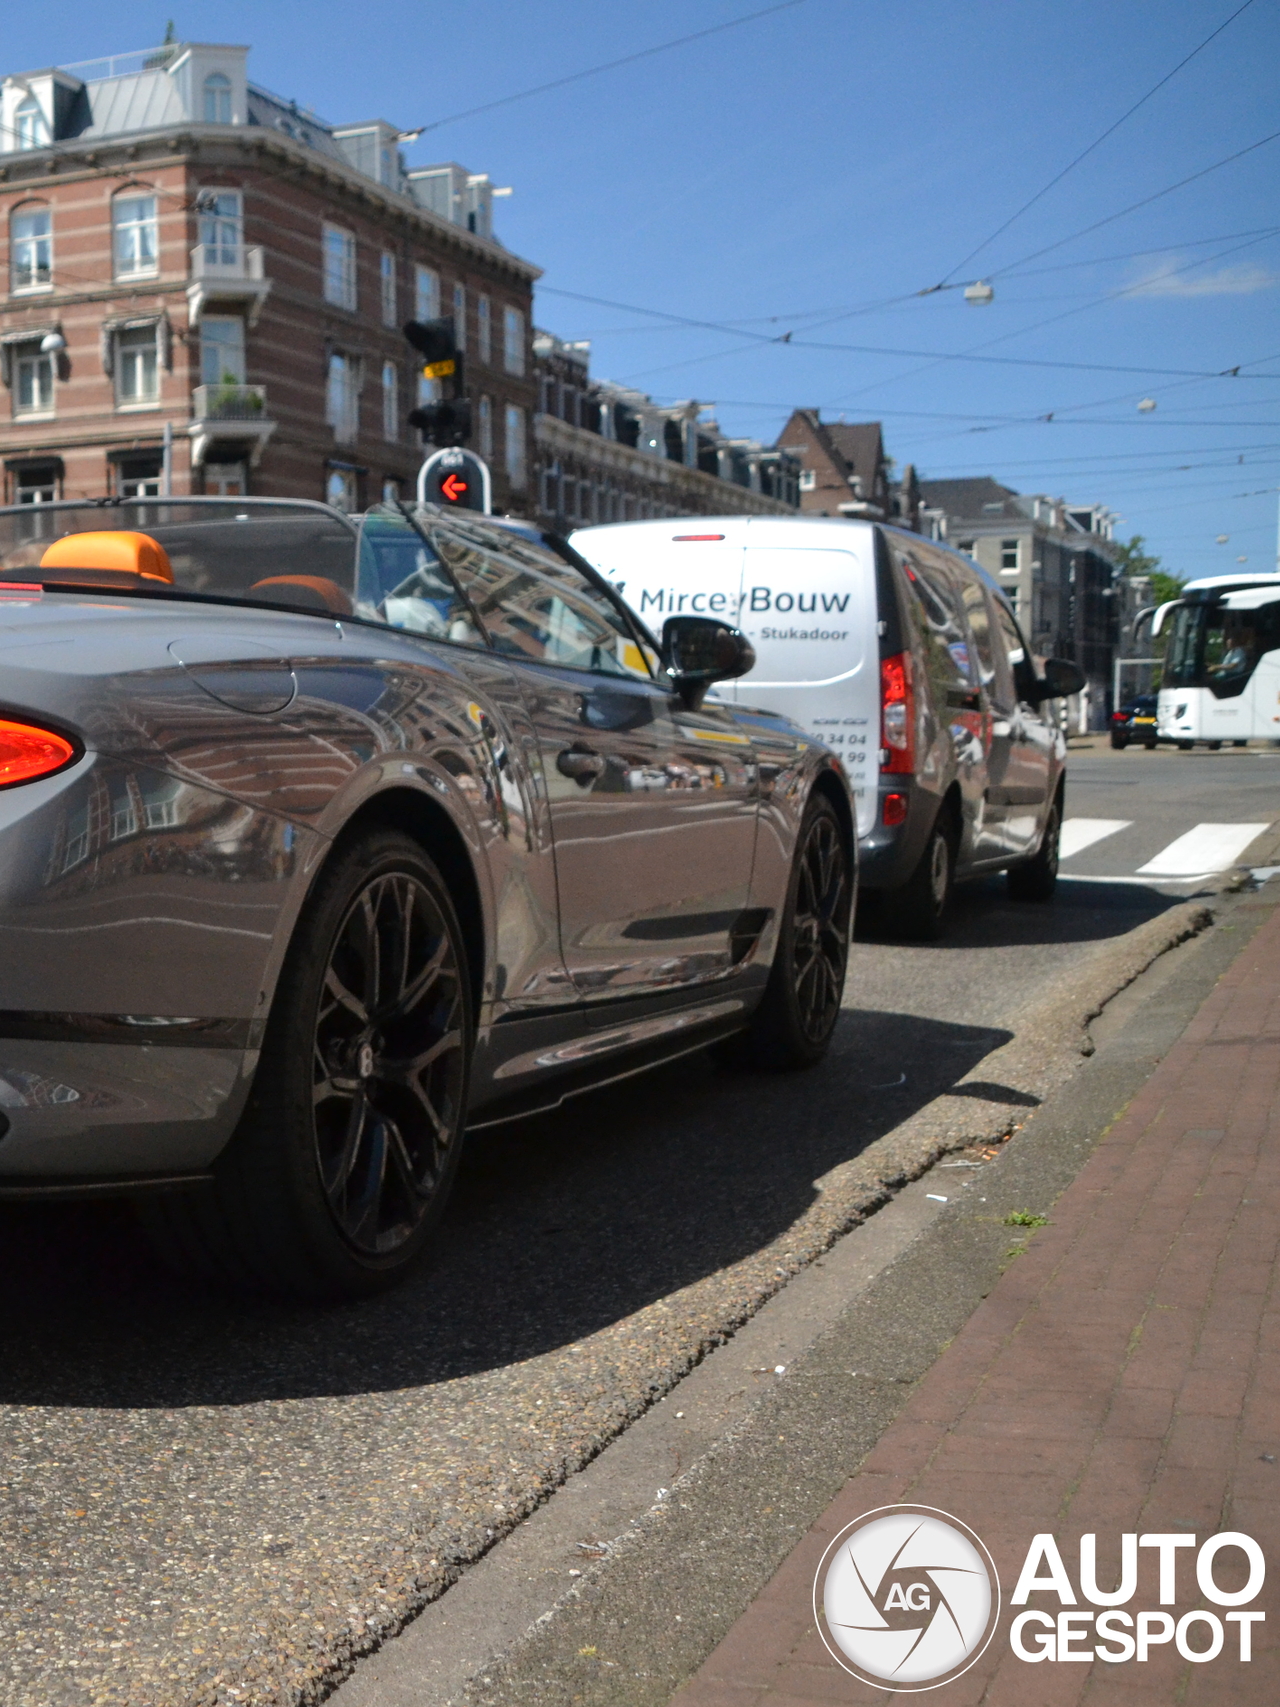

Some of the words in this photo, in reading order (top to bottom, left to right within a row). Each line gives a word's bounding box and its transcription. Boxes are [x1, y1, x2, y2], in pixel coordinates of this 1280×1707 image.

[761, 626, 849, 640] Stukadoor
[828, 733, 844, 744] 34
[848, 734, 867, 744] 04
[848, 751, 867, 763] 99
